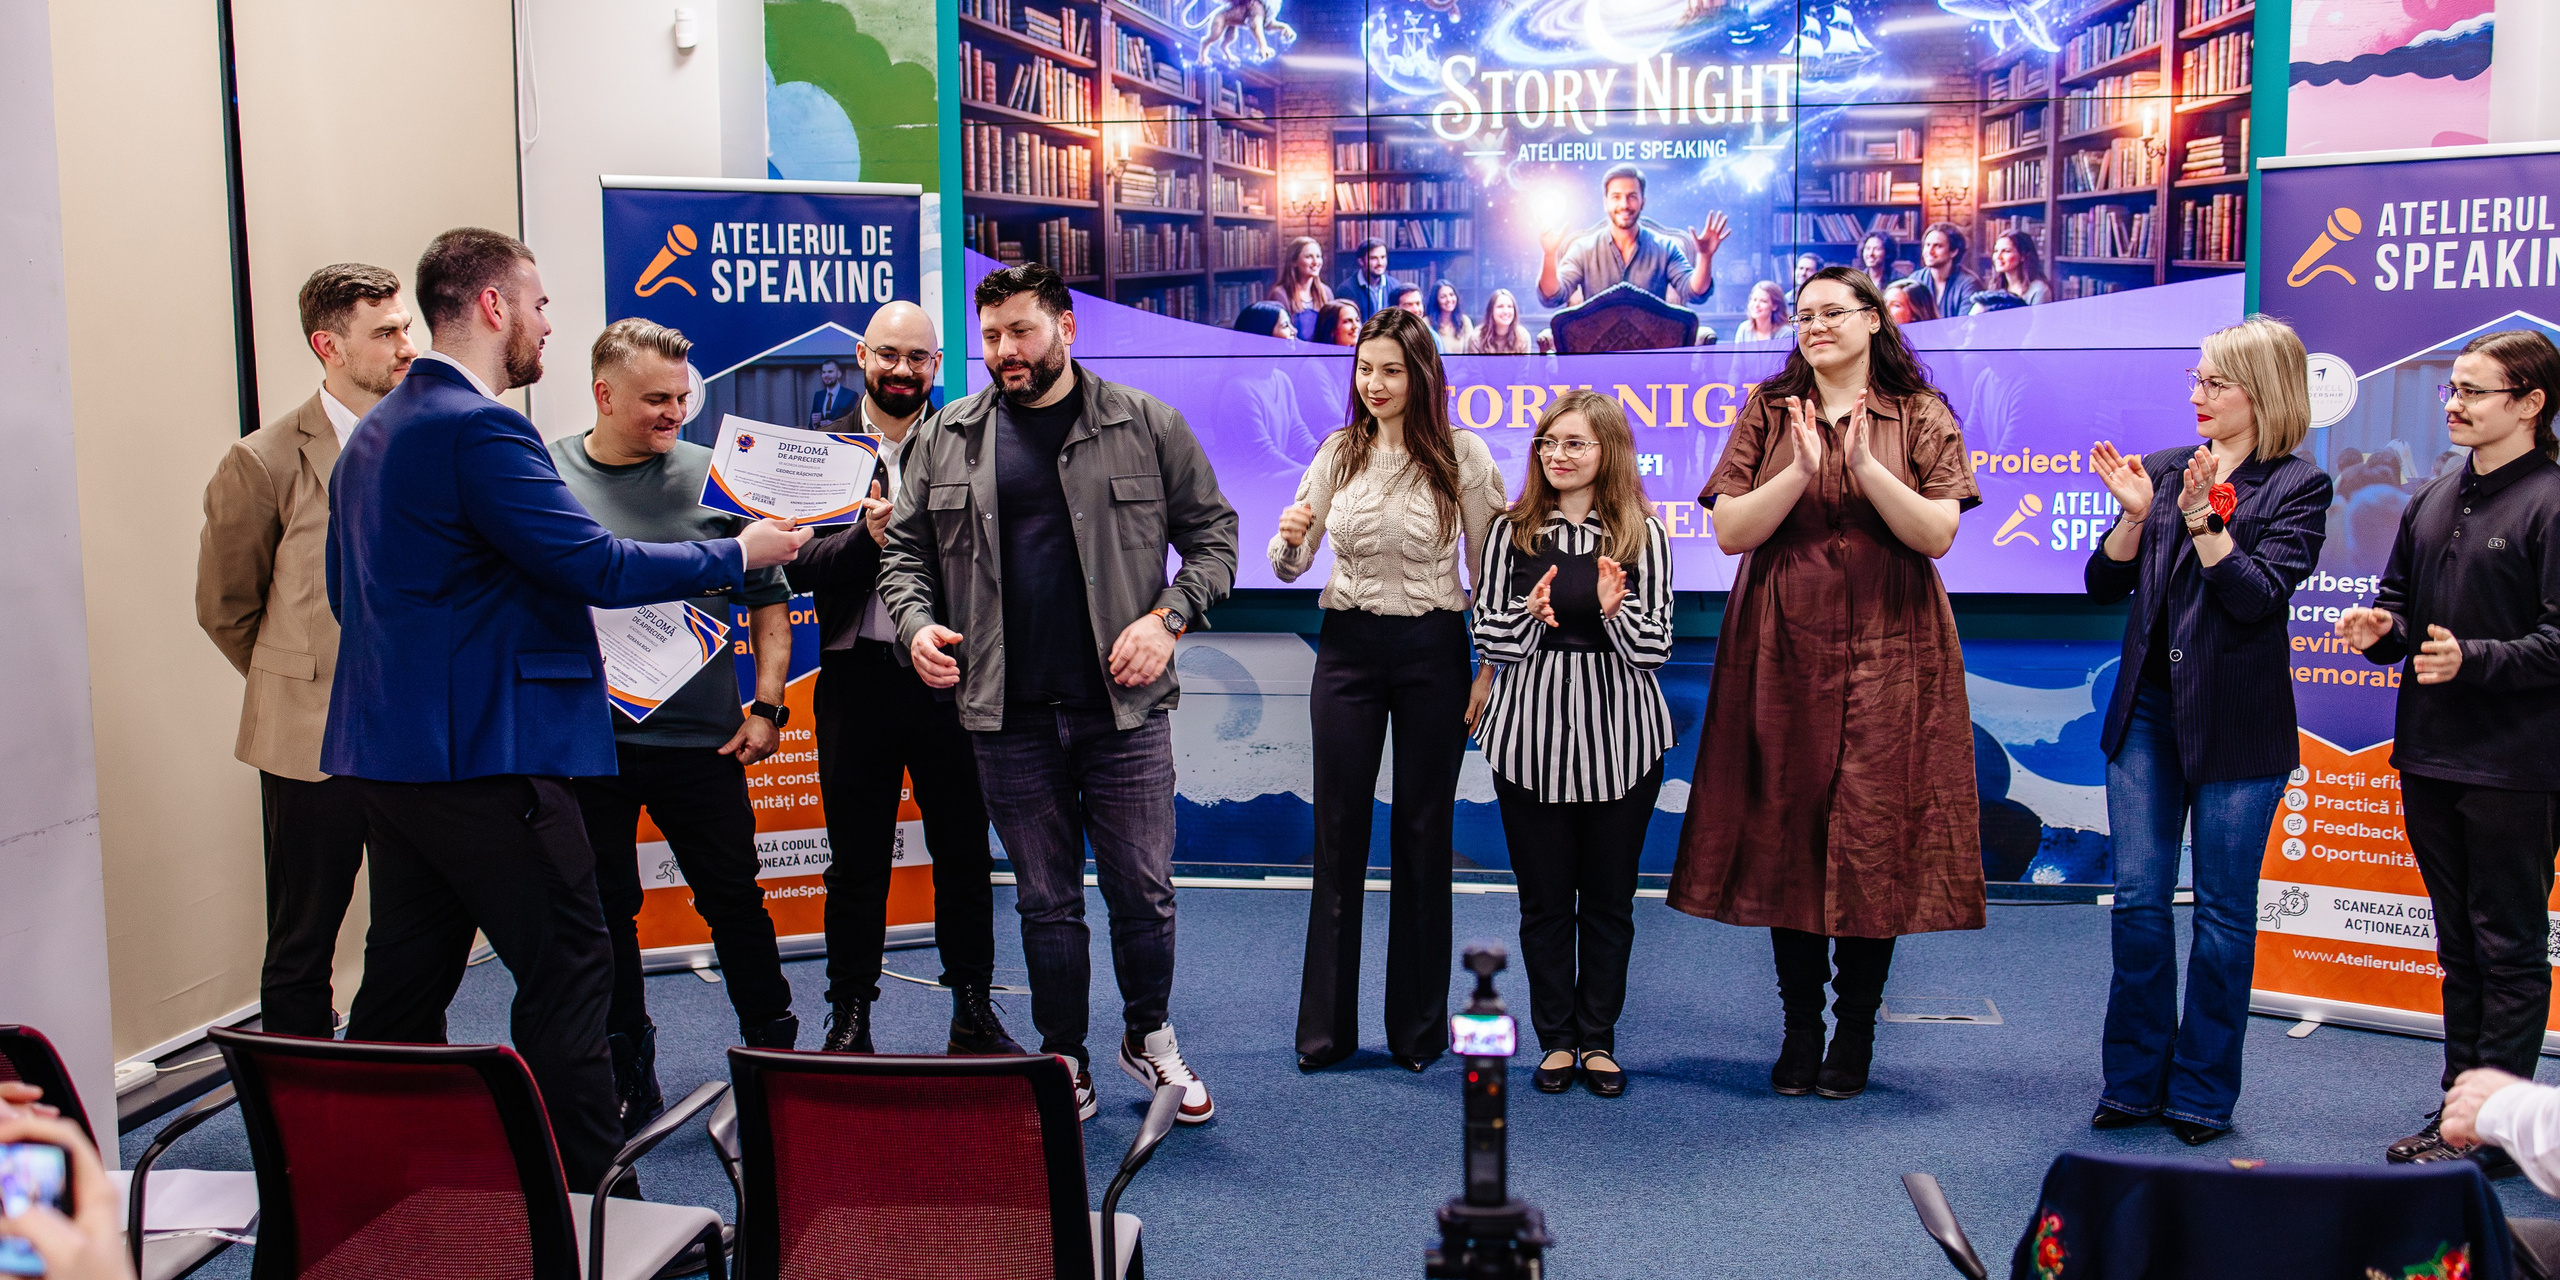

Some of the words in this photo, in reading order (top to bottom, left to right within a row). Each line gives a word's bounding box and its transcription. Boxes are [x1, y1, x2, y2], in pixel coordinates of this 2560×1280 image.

[1518, 140, 1607, 163] ATELIERUL
[1612, 140, 1638, 161] DE
[1642, 138, 1727, 161] SPEAKING
[2377, 195, 2555, 238] ATELIERUL
[711, 222, 852, 256] ATELIERUL
[861, 225, 893, 256] DE
[711, 259, 894, 304] SPEAKING
[1613, 382, 1761, 428] NIG
[777, 452, 788, 460] DE
[788, 454, 826, 464] APRECIERE
[778, 442, 829, 456] DIPLOMĂ
[1970, 447, 2082, 474] Proiect
[1636, 453, 1663, 476] #1
[2051, 518, 2115, 551] SPE
[632, 616, 640, 625] DE
[639, 621, 668, 644] APRECIERE
[637, 605, 678, 637] DIPLOMĂ
[2315, 769, 2366, 790] Lecții
[798, 792, 819, 806] de
[2314, 794, 2389, 815] Practică
[2313, 819, 2405, 841] Feedback
[781, 838, 818, 851] CODUL
[2333, 898, 2404, 917] SCANEAZĂ
[2344, 918, 2430, 938] ACȚIONEAZĂ
